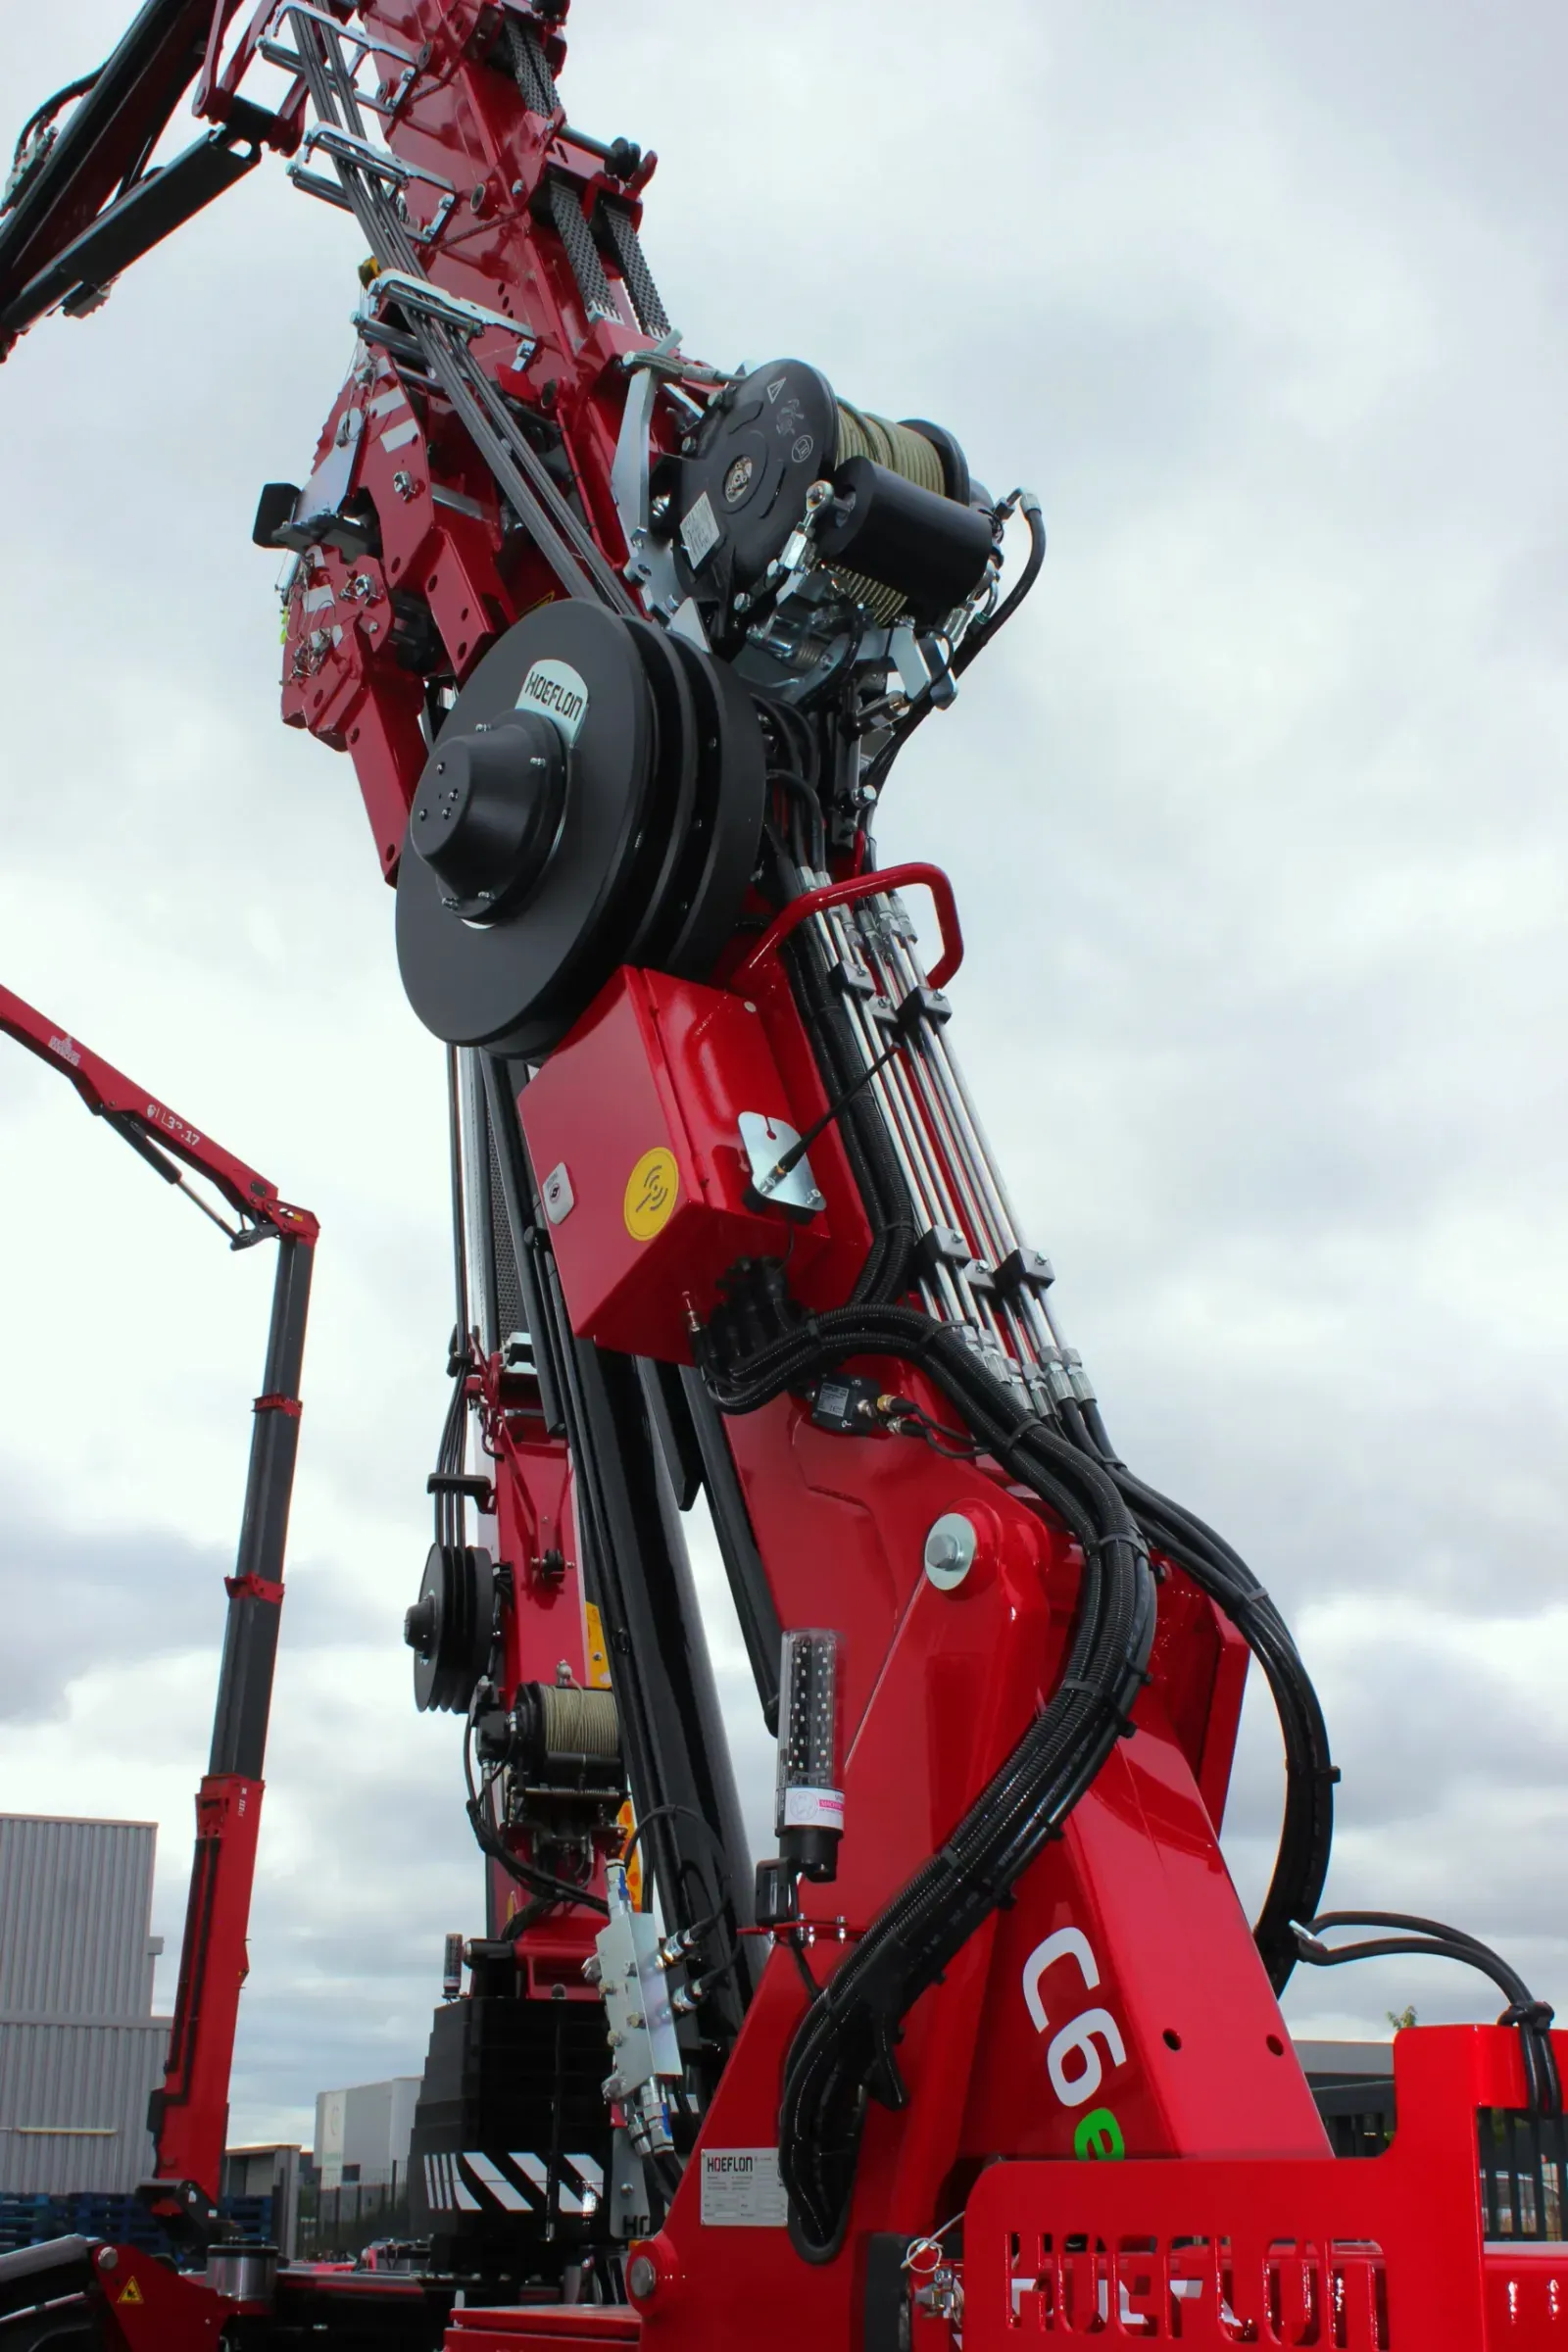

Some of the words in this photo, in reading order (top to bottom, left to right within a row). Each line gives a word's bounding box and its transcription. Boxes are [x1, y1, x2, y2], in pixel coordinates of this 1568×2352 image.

[524, 670, 583, 721] HOEFLON
[707, 2156, 754, 2173] HOEFLON
[1004, 2232, 1391, 2352] HOEFLON
